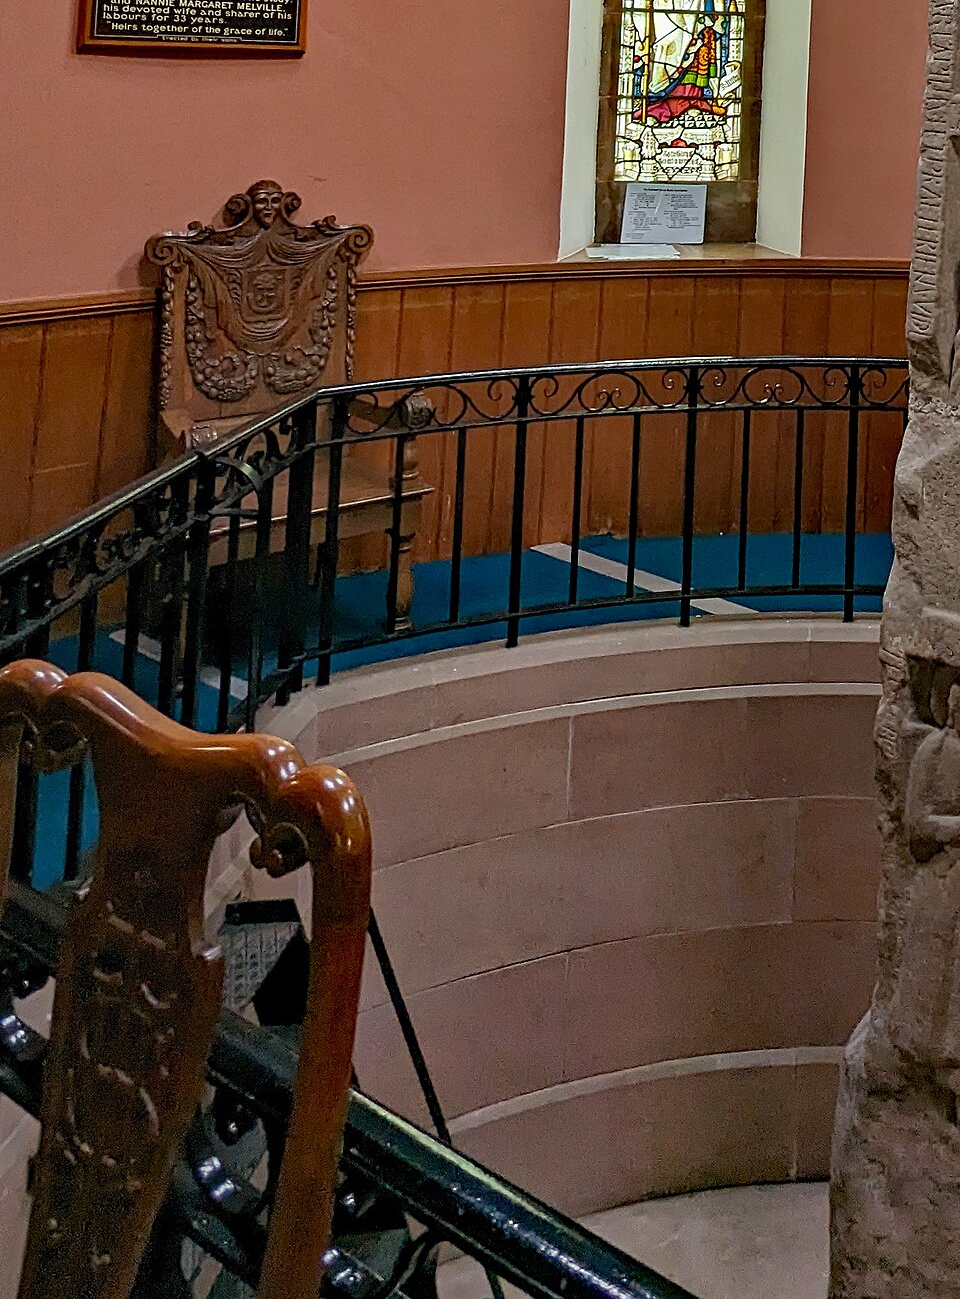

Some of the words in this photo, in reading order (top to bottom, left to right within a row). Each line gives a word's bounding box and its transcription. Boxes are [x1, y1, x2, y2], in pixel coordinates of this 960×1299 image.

[122, 5, 170, 13] devoted
[179, 0, 234, 9] MARGARET
[102, 11, 147, 21] labours
[190, 16, 227, 25] years.
[141, 24, 189, 33] together
[223, 27, 252, 35] grace
